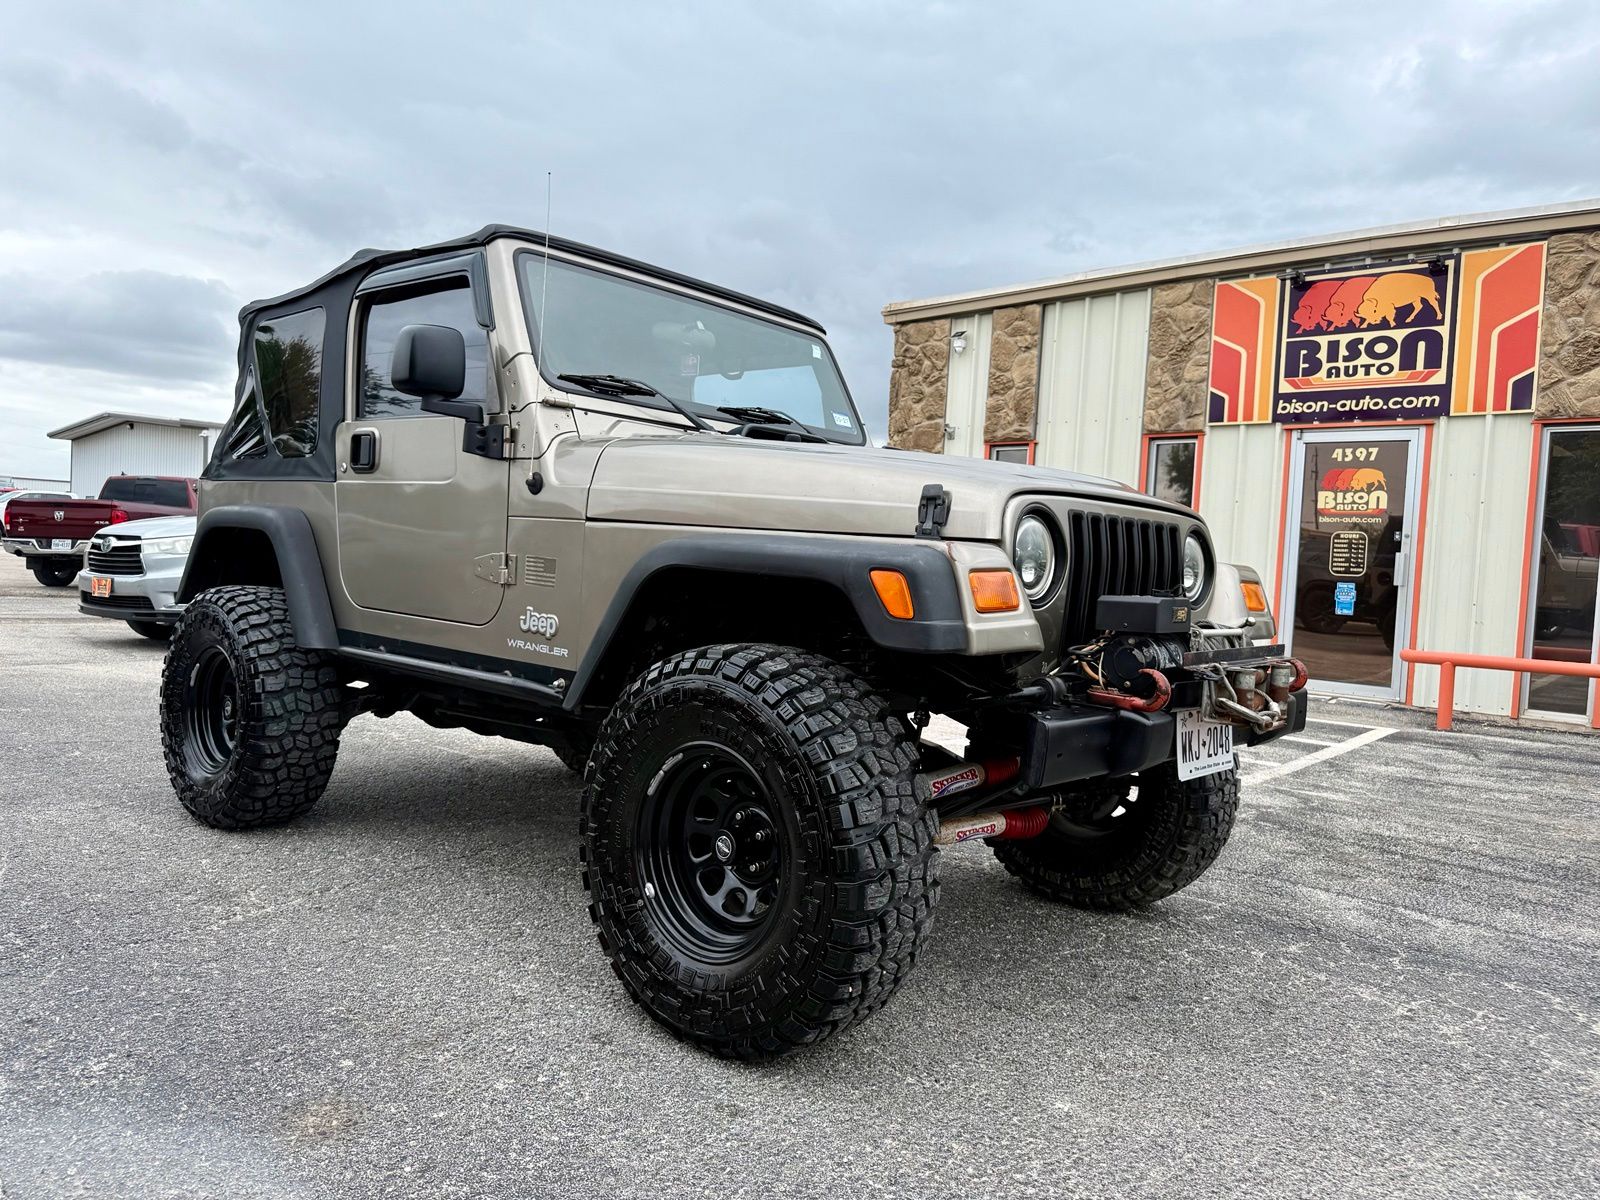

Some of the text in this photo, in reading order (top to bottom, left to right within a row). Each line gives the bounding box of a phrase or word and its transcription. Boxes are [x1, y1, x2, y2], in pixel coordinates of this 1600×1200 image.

[1285, 329, 1443, 379] BISON
[1327, 363, 1394, 379] AUTO
[1277, 393, 1439, 414] bison-auto.com
[1332, 447, 1379, 462] 4397
[1317, 490, 1388, 509] BISON
[1336, 503, 1367, 511] AUTO
[1319, 515, 1382, 524] bison-auto.com
[520, 606, 559, 640] Jeep
[507, 638, 568, 657] WRANGLER
[1207, 725, 1230, 758] 2048
